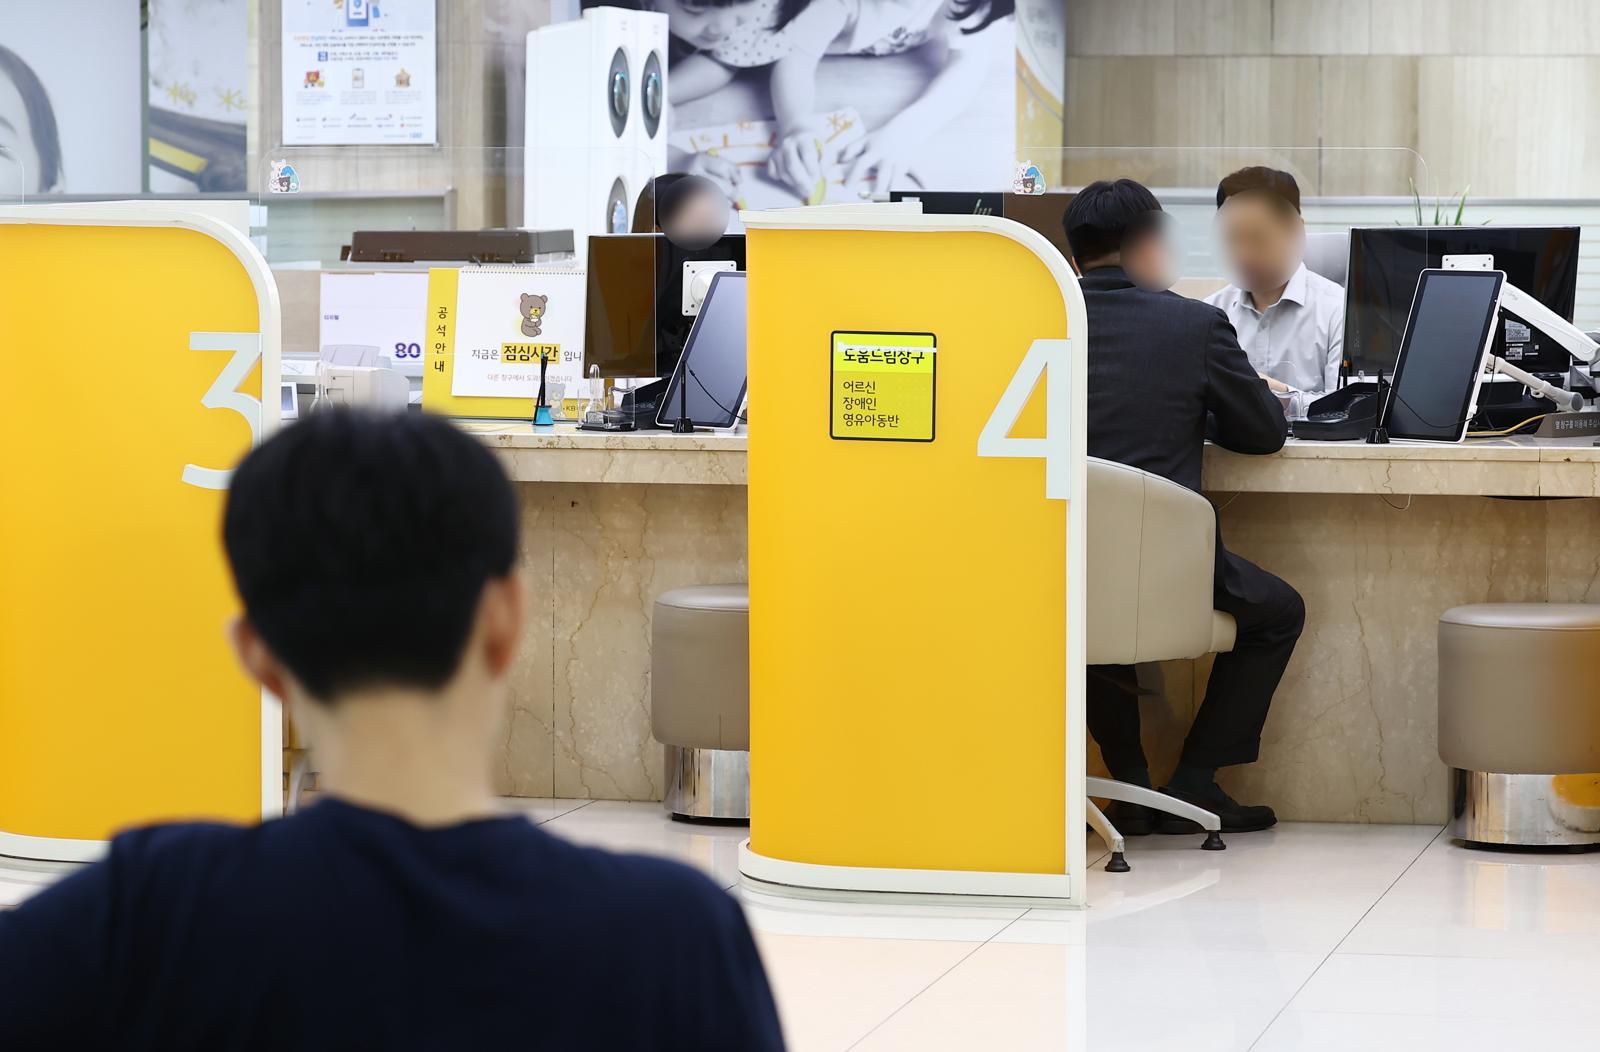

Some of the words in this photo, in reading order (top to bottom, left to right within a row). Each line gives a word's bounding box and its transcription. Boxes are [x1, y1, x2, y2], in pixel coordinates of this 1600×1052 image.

[434, 306, 448, 373] 공석안내
[395, 342, 421, 359] 80
[471, 349, 500, 360] 지금은
[503, 345, 559, 361] 점심시간
[563, 350, 582, 361] 입니
[843, 348, 925, 365] 도움드림창구
[843, 380, 876, 394] 어르신
[181, 332, 262, 490] 3
[843, 396, 877, 410] 장애인
[843, 413, 900, 428] 영유아동반
[976, 338, 1072, 500] 4
